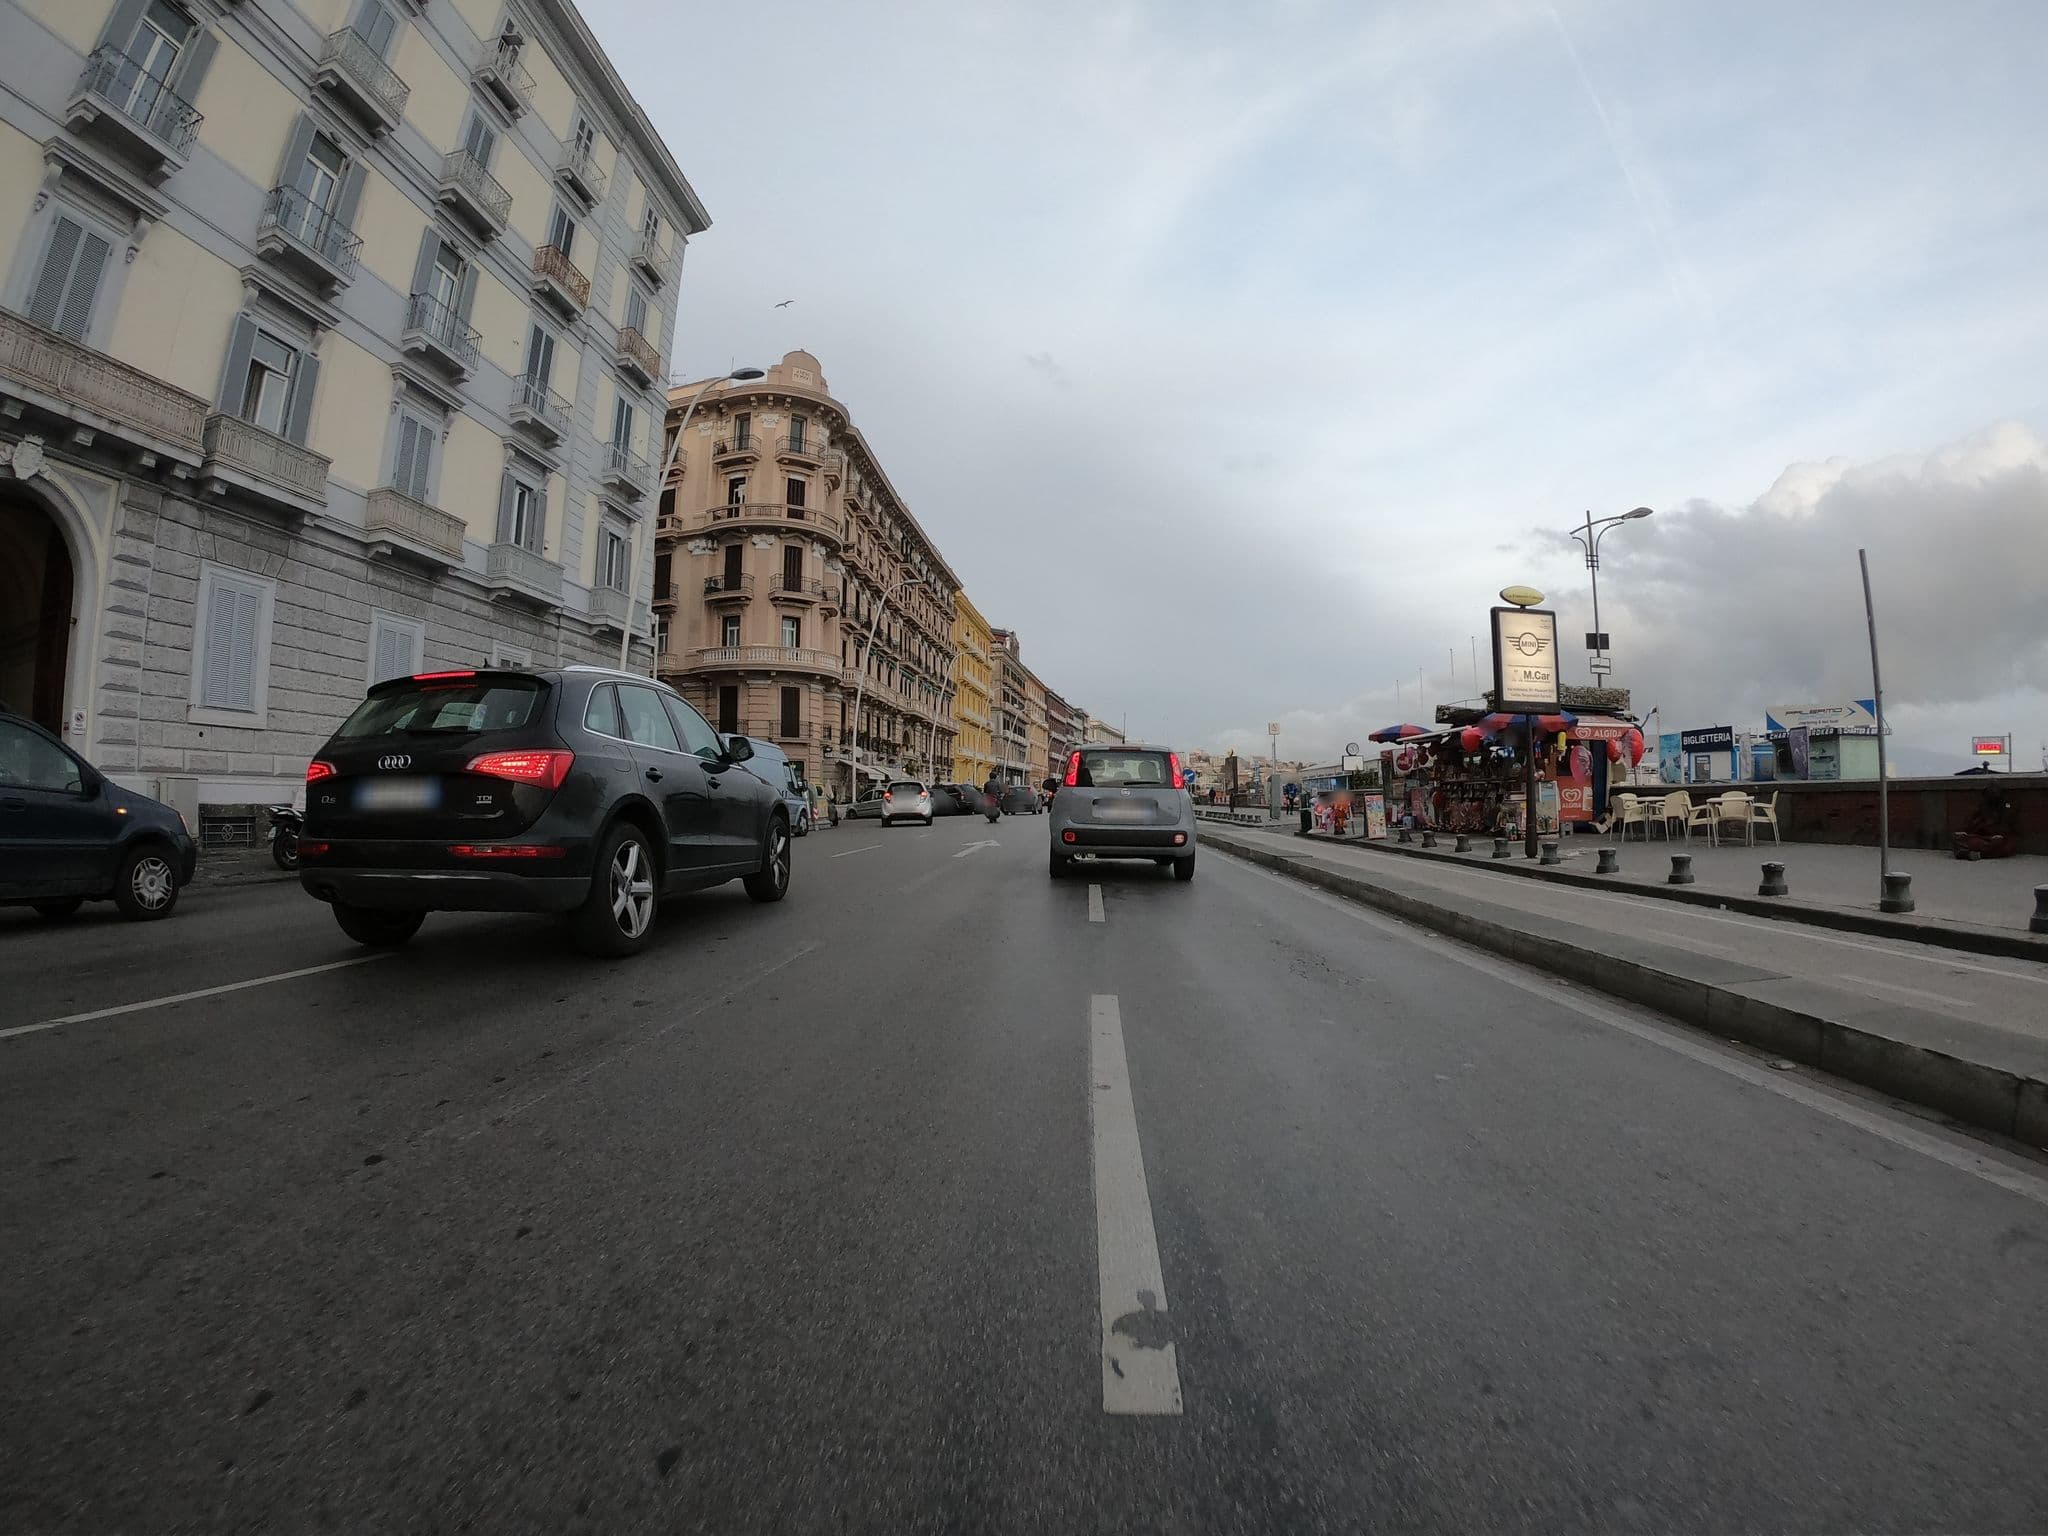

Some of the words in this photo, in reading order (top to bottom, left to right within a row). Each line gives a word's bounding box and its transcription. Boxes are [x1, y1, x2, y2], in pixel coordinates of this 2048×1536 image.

[1521, 640, 1537, 648] MINI
[1523, 670, 1551, 681] M.Car
[1593, 729, 1622, 738] ALGIDA
[1682, 732, 1731, 745] BIGLIETTERIA
